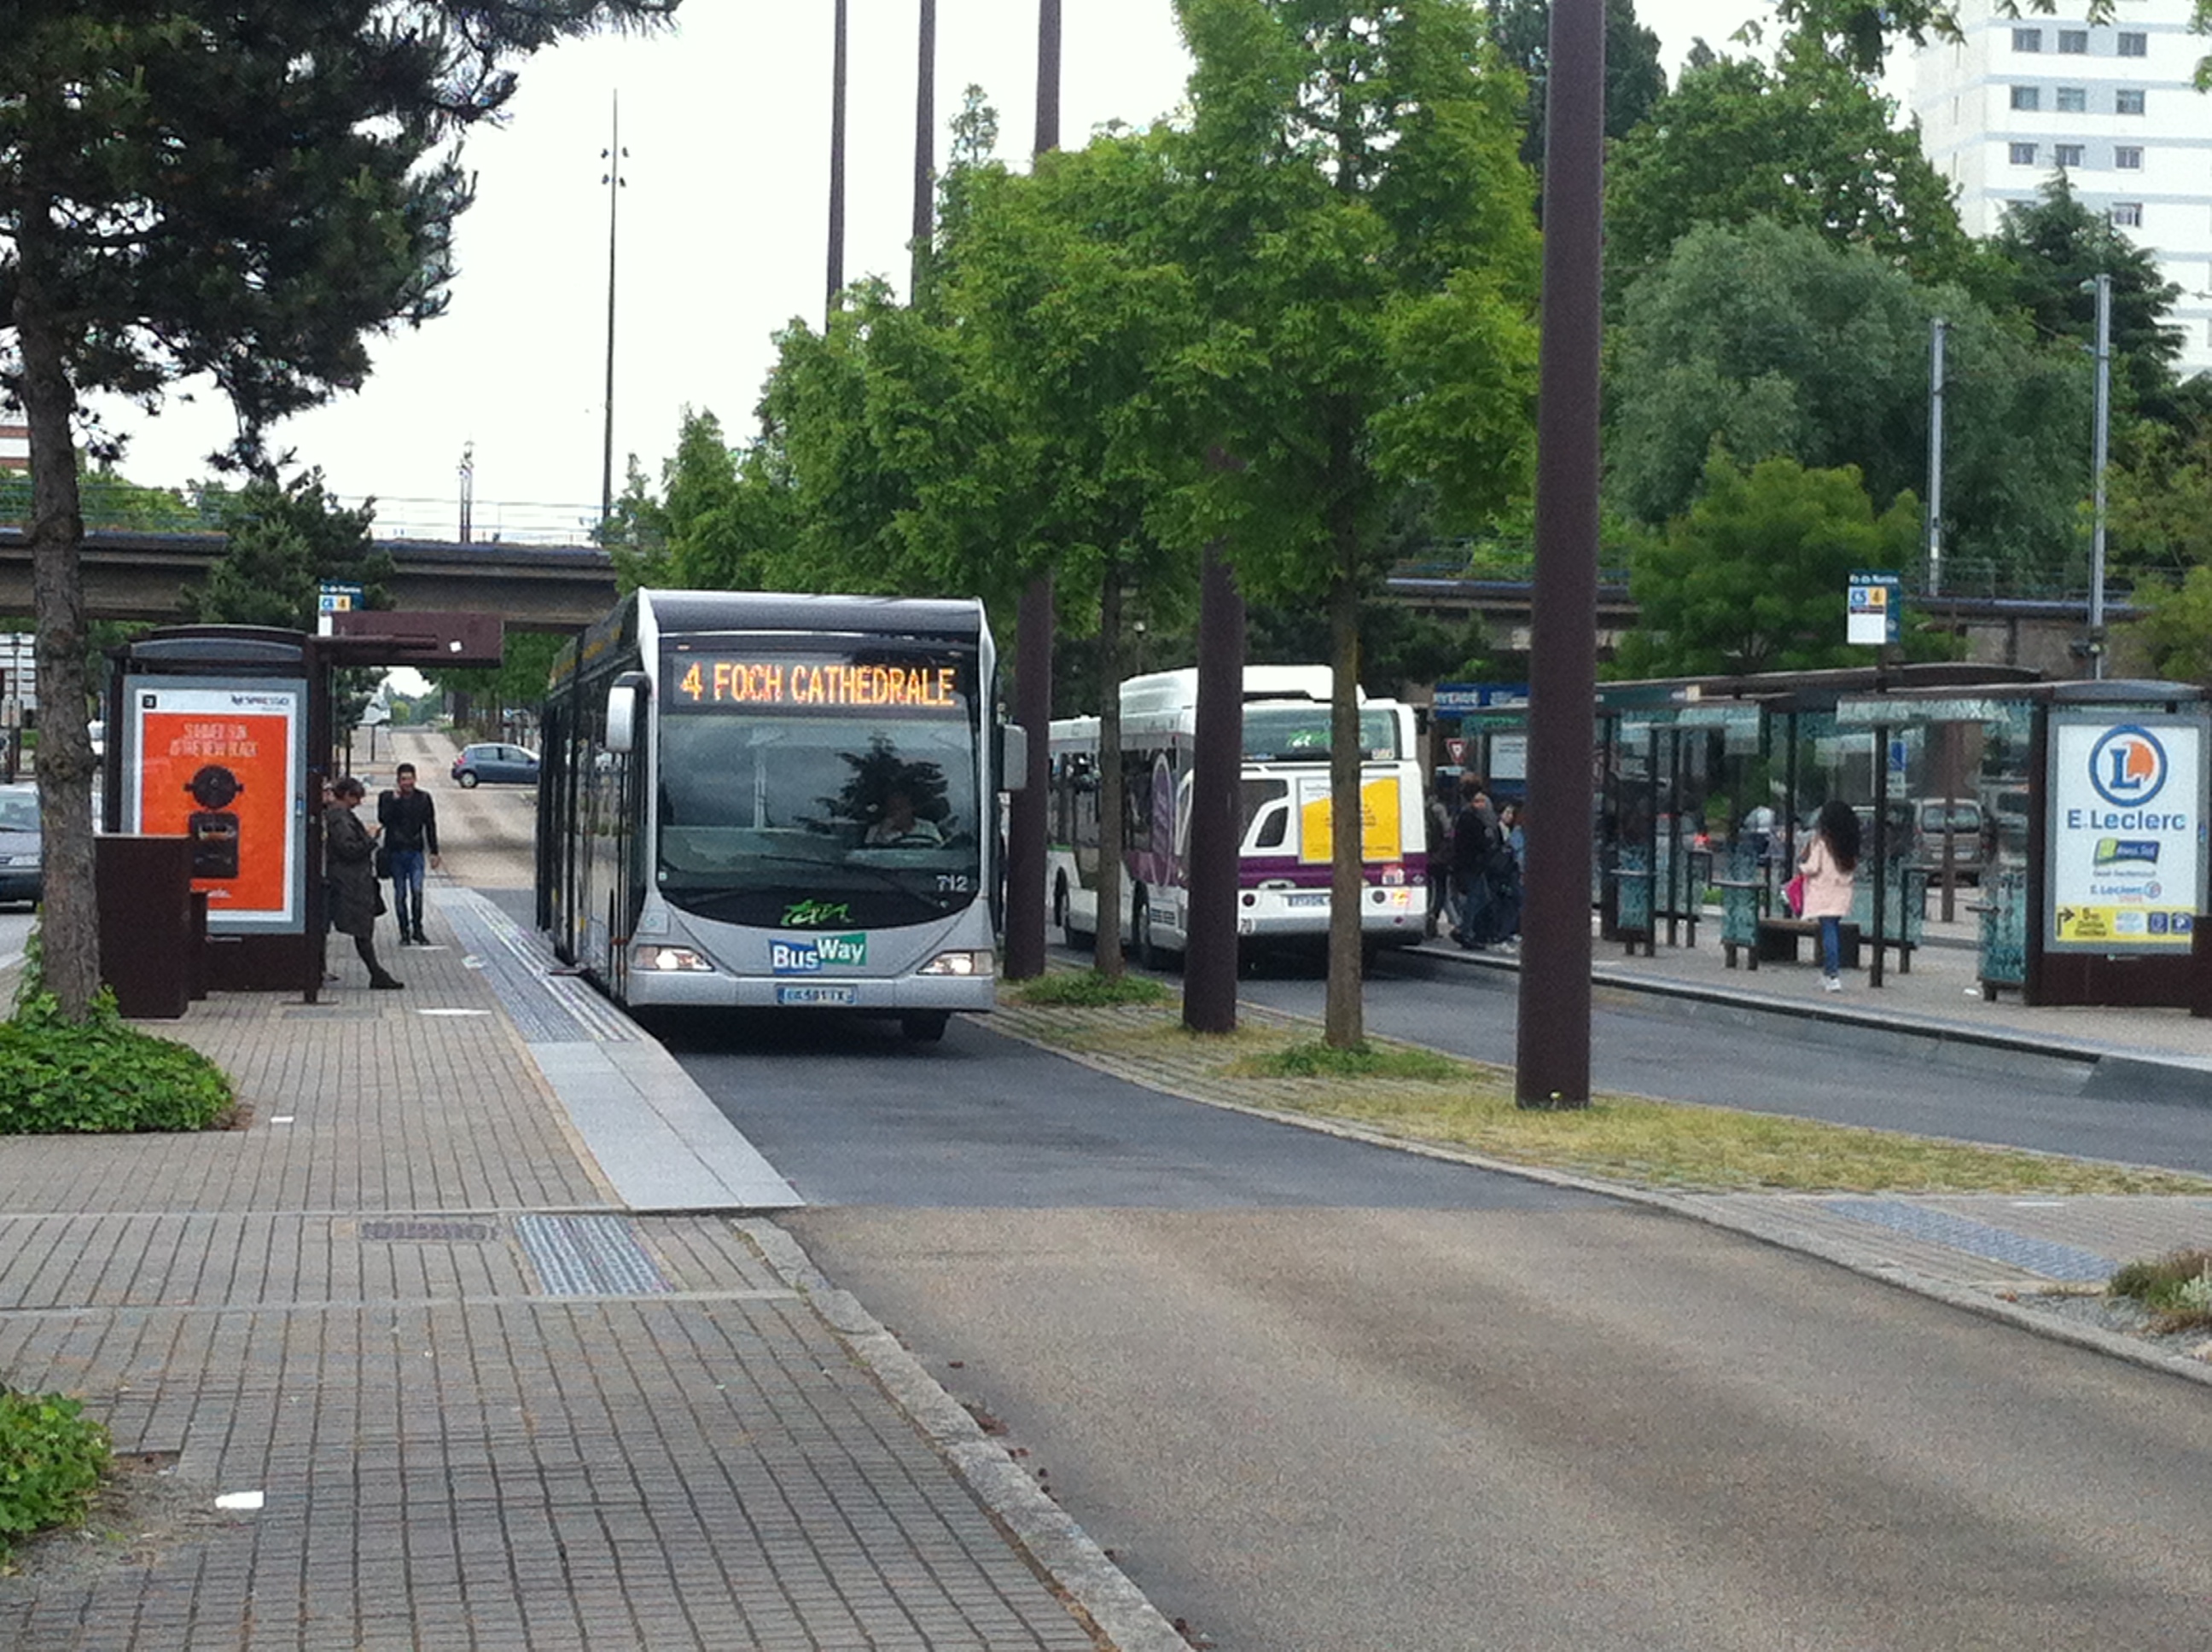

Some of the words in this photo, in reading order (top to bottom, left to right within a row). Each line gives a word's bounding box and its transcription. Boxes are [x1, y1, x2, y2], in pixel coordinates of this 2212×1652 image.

[680, 662, 703, 701] 4
[713, 662, 784, 701] FOCH
[790, 664, 957, 706] CATHEDRALE
[2067, 808, 2187, 830] E.Leclerc
[936, 875, 969, 893] 712
